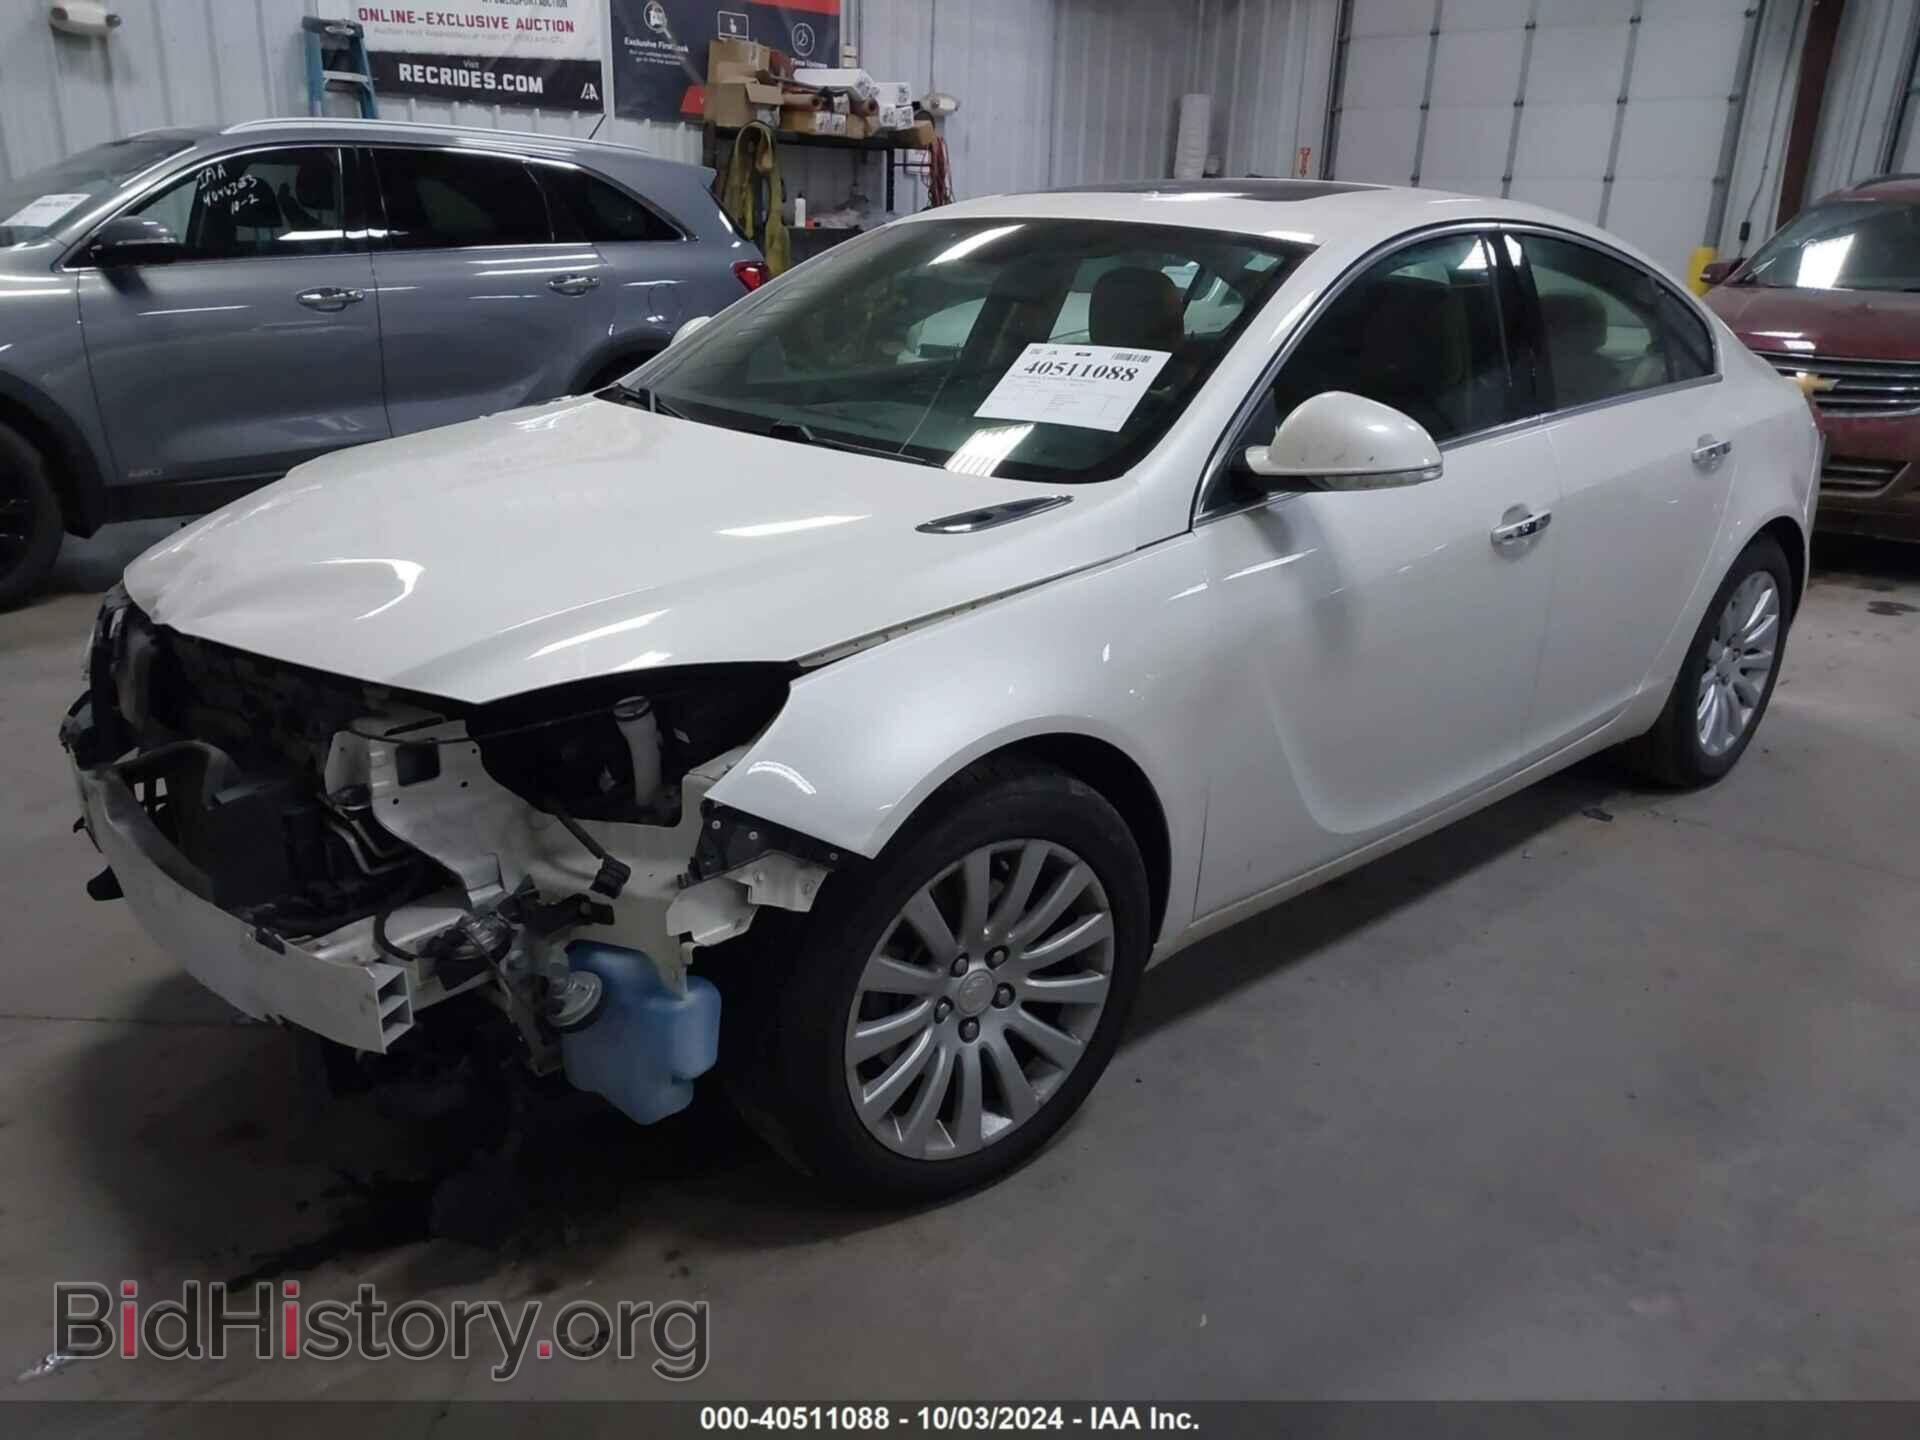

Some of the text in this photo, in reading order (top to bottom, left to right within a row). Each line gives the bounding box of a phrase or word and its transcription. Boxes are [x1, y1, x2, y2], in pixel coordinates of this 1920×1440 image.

[358, 7, 575, 33] ONLINE-EXCLUSIVE AUCTION
[398, 63, 544, 94] RECRIDES.COM
[1024, 360, 1139, 383] 40511088
